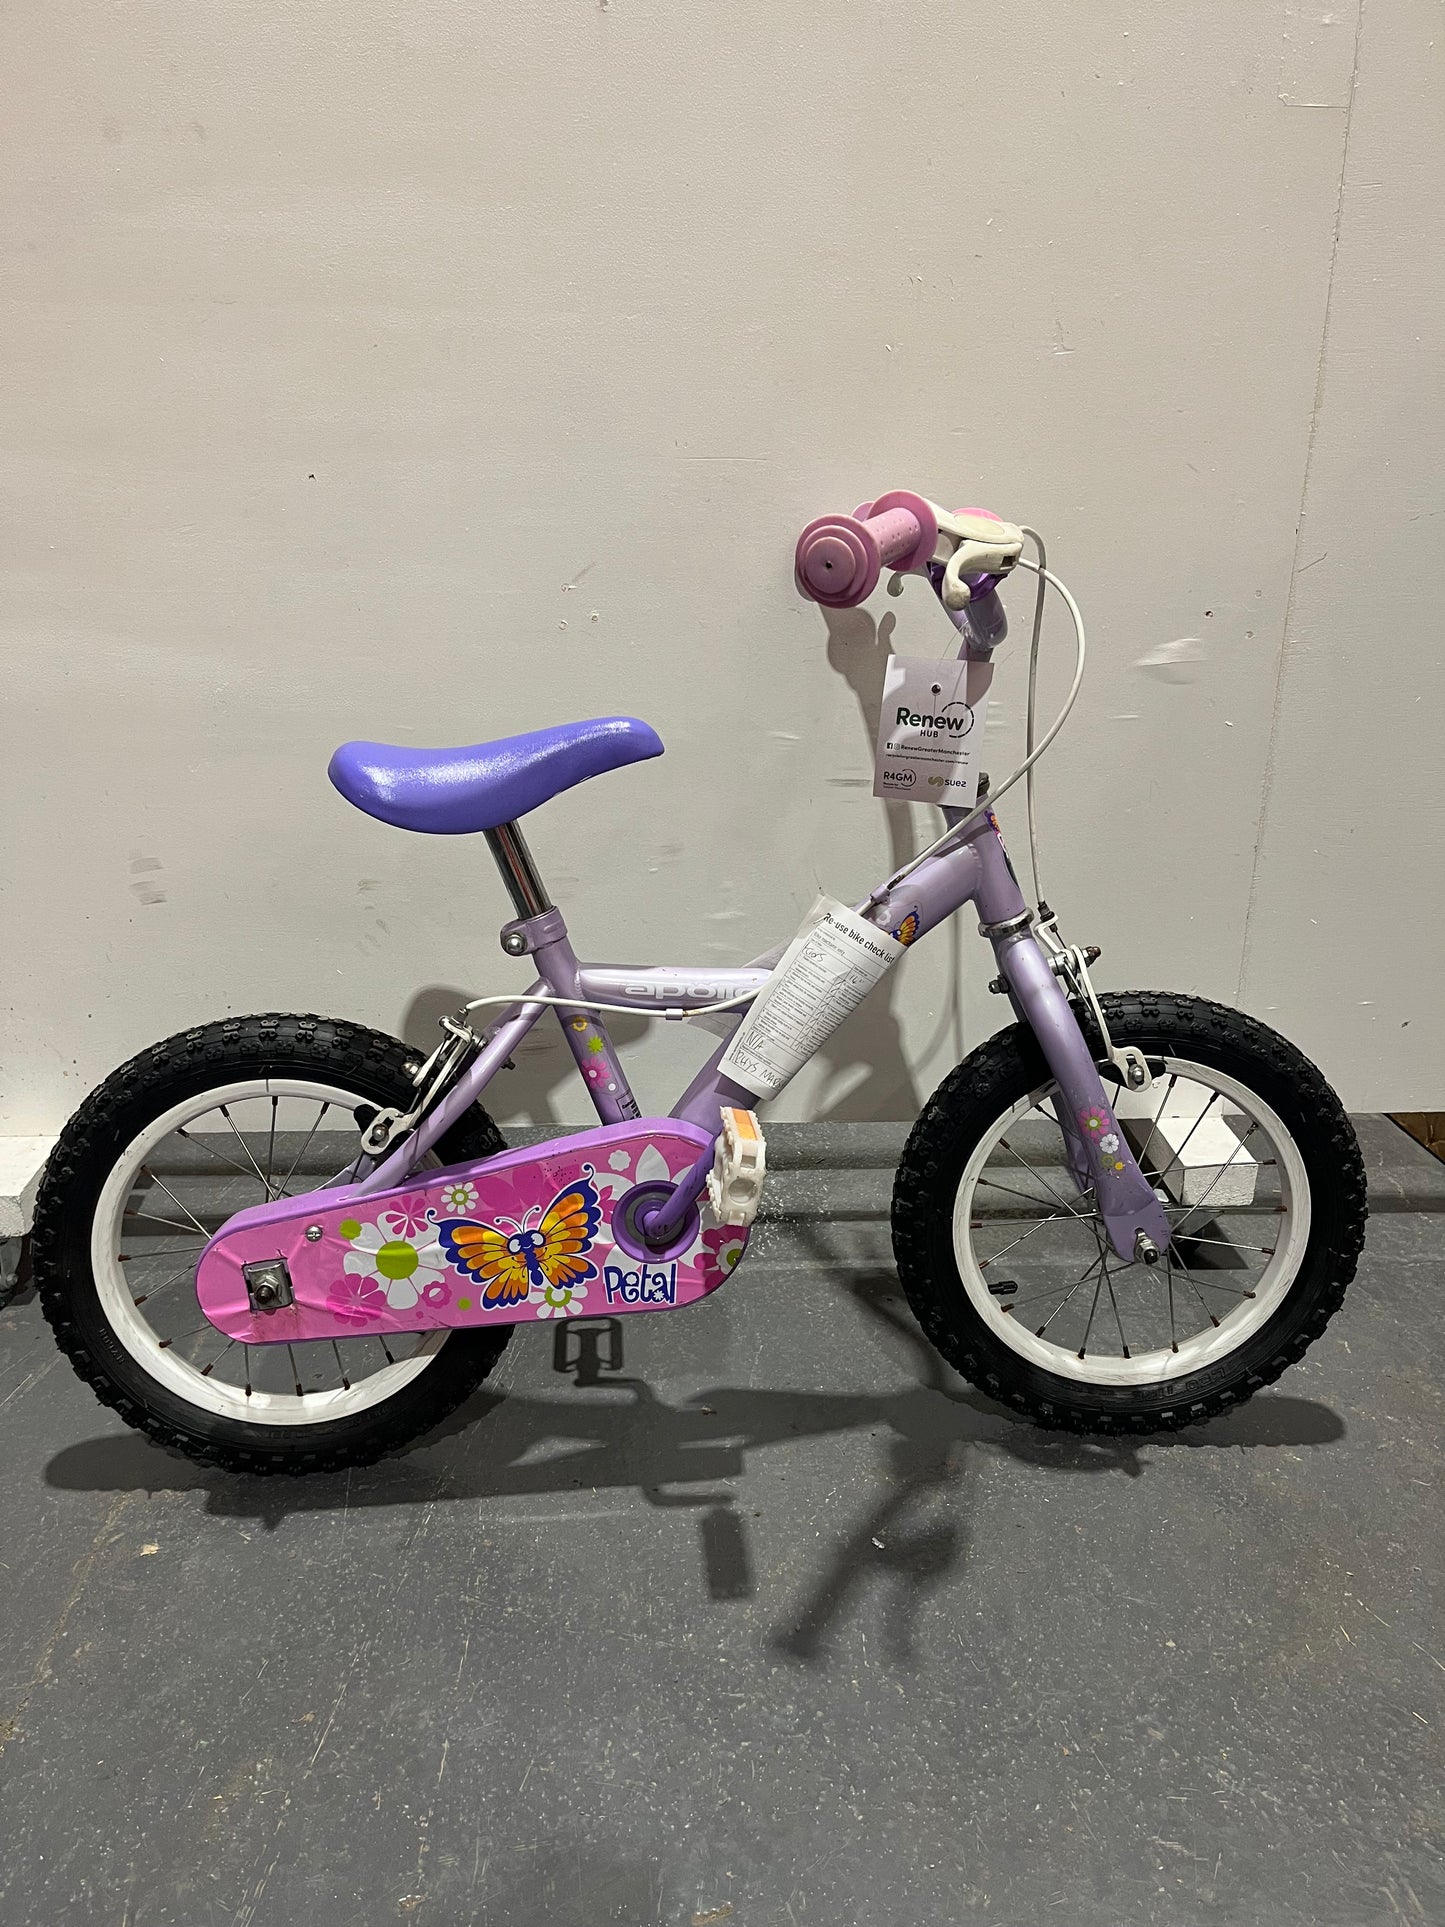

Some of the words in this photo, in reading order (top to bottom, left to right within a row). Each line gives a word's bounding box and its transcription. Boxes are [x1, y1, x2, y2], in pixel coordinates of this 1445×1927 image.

[896, 707, 964, 731] Renew
[920, 730, 939, 738] HUB
[883, 771, 913, 782] R4GM
[944, 779, 967, 787] suez
[823, 912, 849, 934] Re-use
[848, 928, 865, 945] bike
[864, 941, 886, 959] check
[883, 952, 896, 964] list
[603, 1263, 677, 1304] Petal
